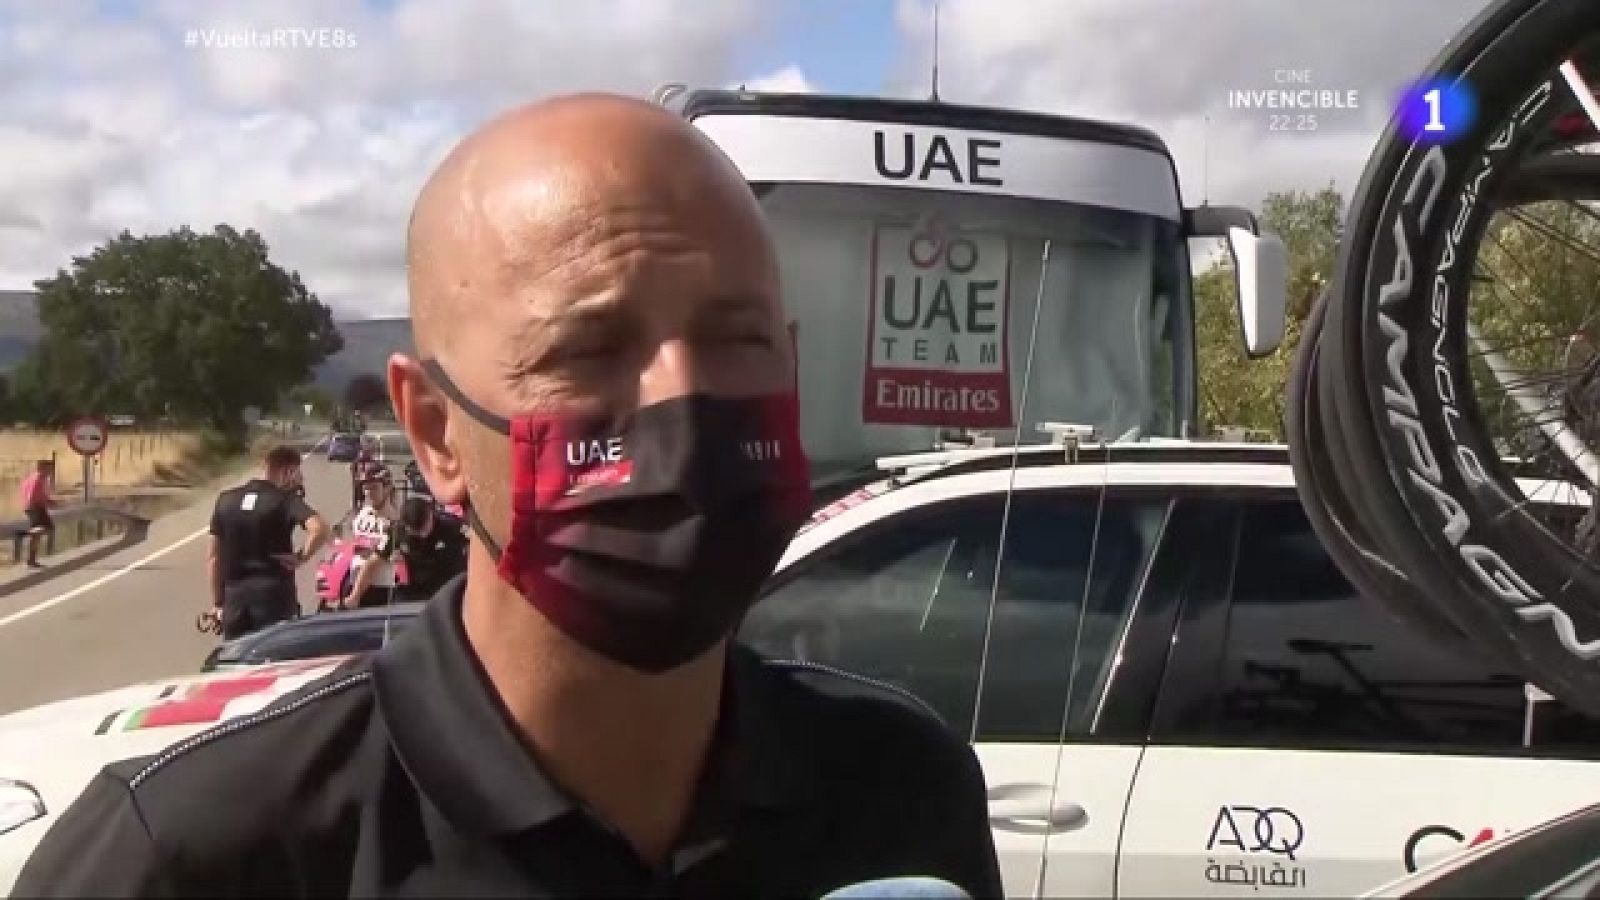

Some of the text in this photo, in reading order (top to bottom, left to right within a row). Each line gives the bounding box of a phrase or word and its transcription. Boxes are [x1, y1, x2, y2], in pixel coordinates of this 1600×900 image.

[874, 130, 1003, 186] UAE
[884, 276, 999, 333] UAE
[881, 337, 997, 364] TEAM
[876, 378, 999, 412] Emirates
[567, 437, 623, 465] UAE
[1207, 804, 1304, 860] ADQ
[1205, 859, 1306, 890] القابضة
